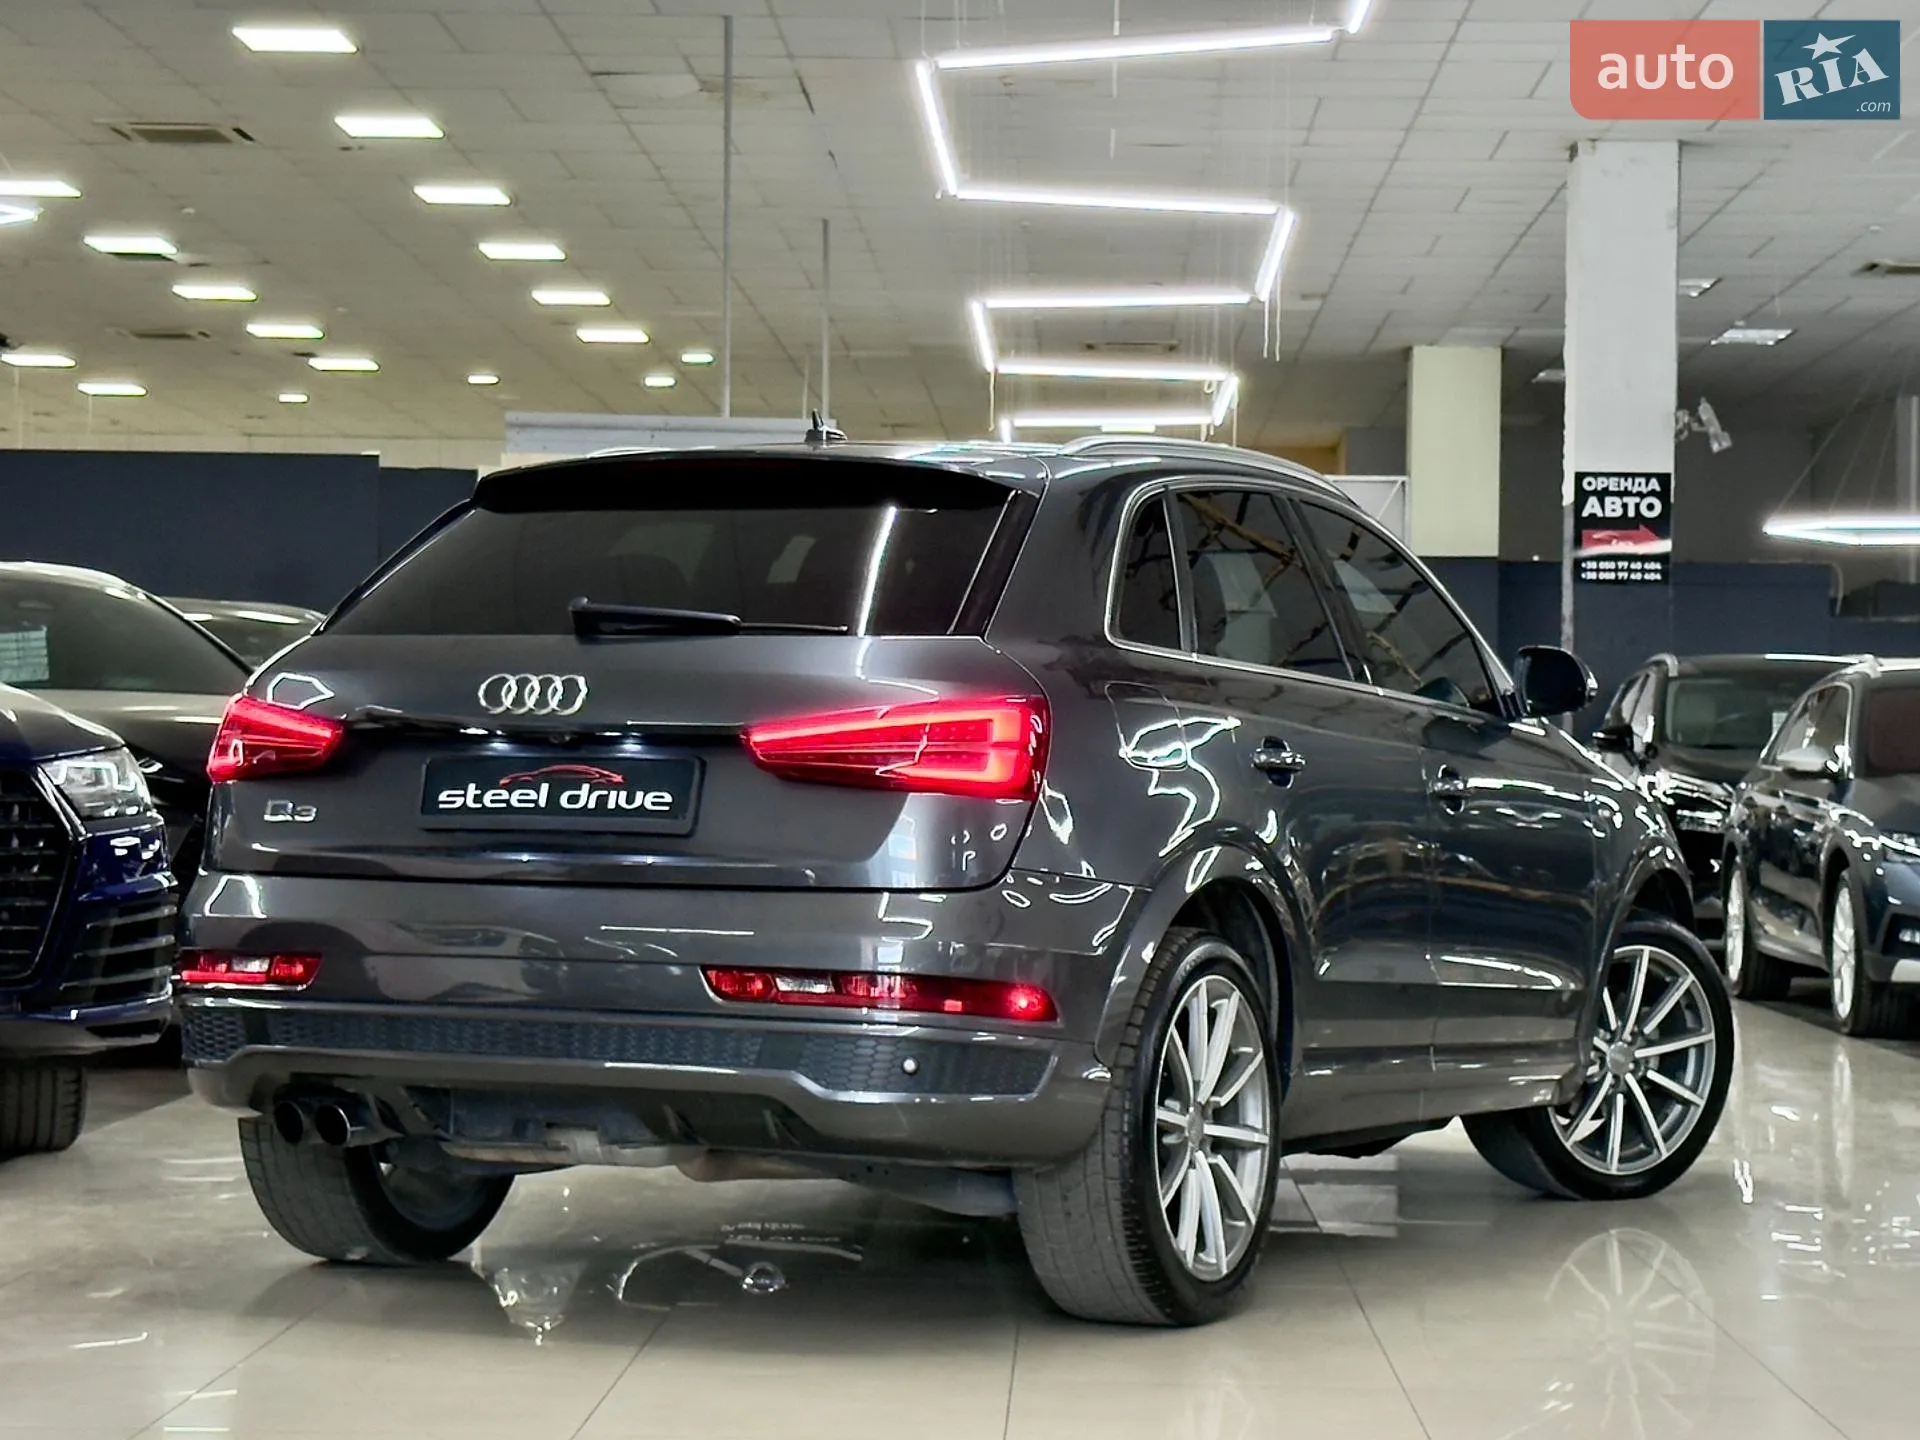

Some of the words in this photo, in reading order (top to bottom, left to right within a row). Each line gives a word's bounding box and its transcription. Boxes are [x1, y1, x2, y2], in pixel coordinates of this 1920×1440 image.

[1582, 477, 1661, 494] ОРЕНДА
[1581, 496, 1662, 518] АВТО
[438, 782, 549, 809] steel
[559, 783, 673, 811] drive
[264, 800, 317, 821] Q3
